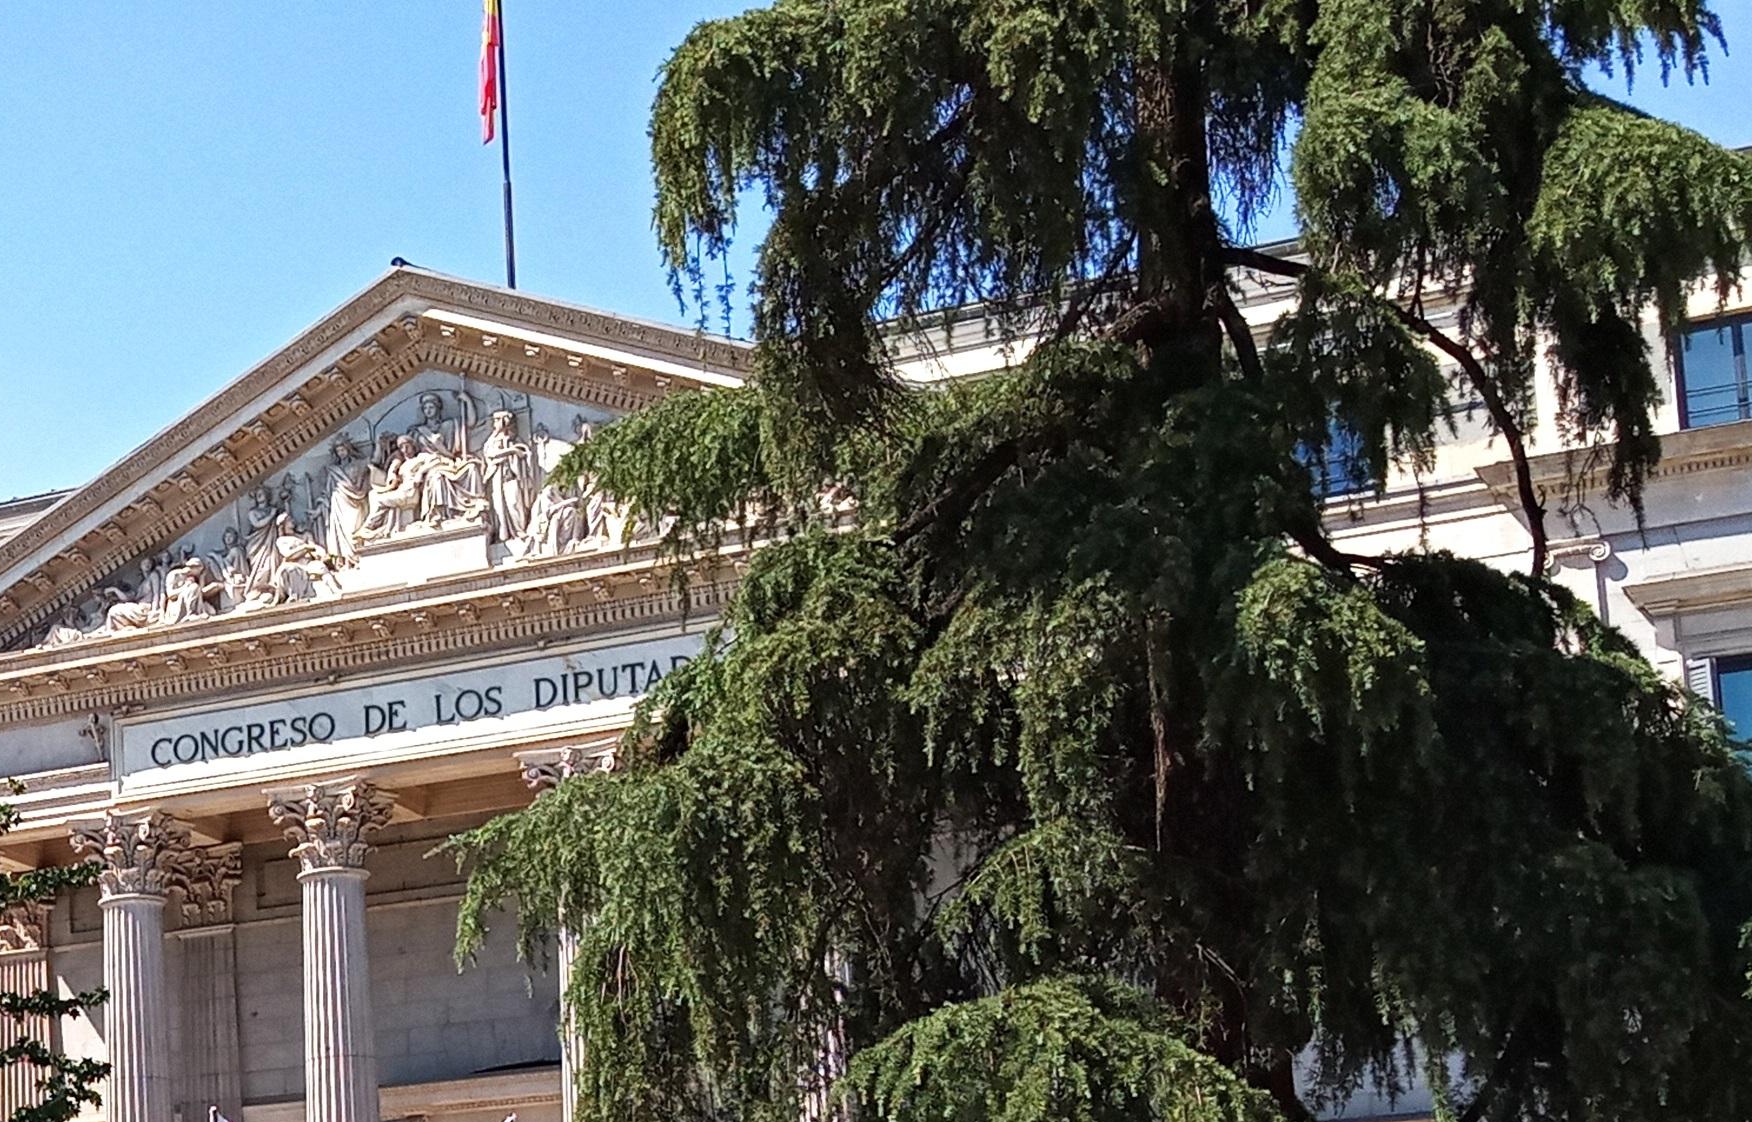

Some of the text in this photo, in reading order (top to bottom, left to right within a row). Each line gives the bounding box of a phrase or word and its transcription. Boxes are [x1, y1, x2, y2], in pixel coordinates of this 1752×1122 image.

[150, 711, 336, 768] CONGRESO
[364, 699, 408, 737] DE
[435, 686, 503, 725] LOS
